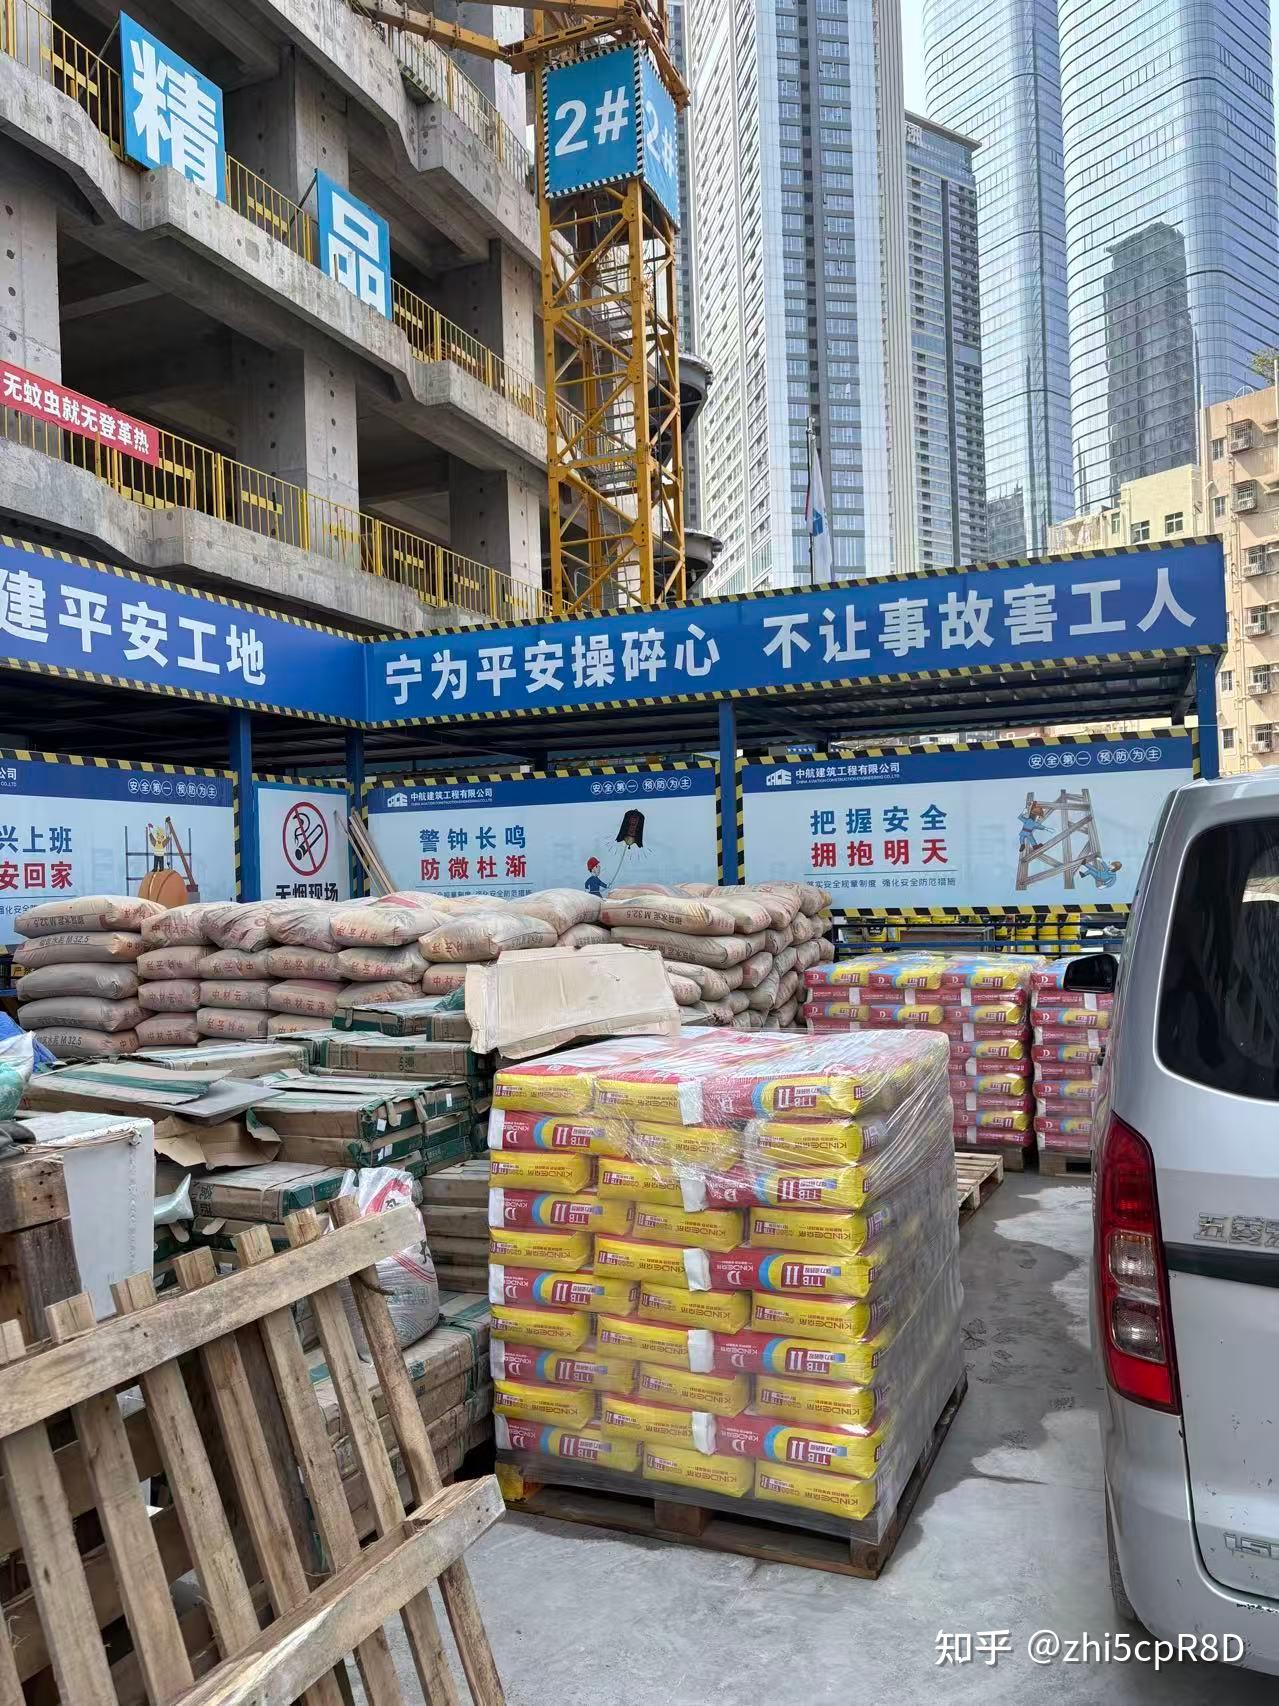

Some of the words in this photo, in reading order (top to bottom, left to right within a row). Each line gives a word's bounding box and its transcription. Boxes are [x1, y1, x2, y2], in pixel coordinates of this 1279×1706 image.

[131, 39, 219, 197] 精
[554, 87, 629, 157] 2#
[328, 191, 385, 306] 品
[3, 371, 149, 457] 无蚊虫就无登革热
[0, 568, 266, 686] 建平安工地
[385, 622, 720, 705] 宁为平安操碎心
[762, 567, 1197, 669] 不让事故害工人
[796, 762, 900, 779] 中航建筑工程有限公司
[1028, 751, 1091, 769] 安全第一
[1097, 746, 1161, 765] 预防为主
[128, 778, 173, 796] 安全第一
[411, 788, 493, 802] 中航建筑工程有限公司
[590, 779, 638, 795] 安全第一
[810, 804, 948, 835] 把握安全
[420, 824, 526, 852] 警钟长鸣
[421, 854, 527, 880] 防微杜渐
[811, 839, 948, 868] 拥抱明天
[0, 861, 73, 889] 安回家
